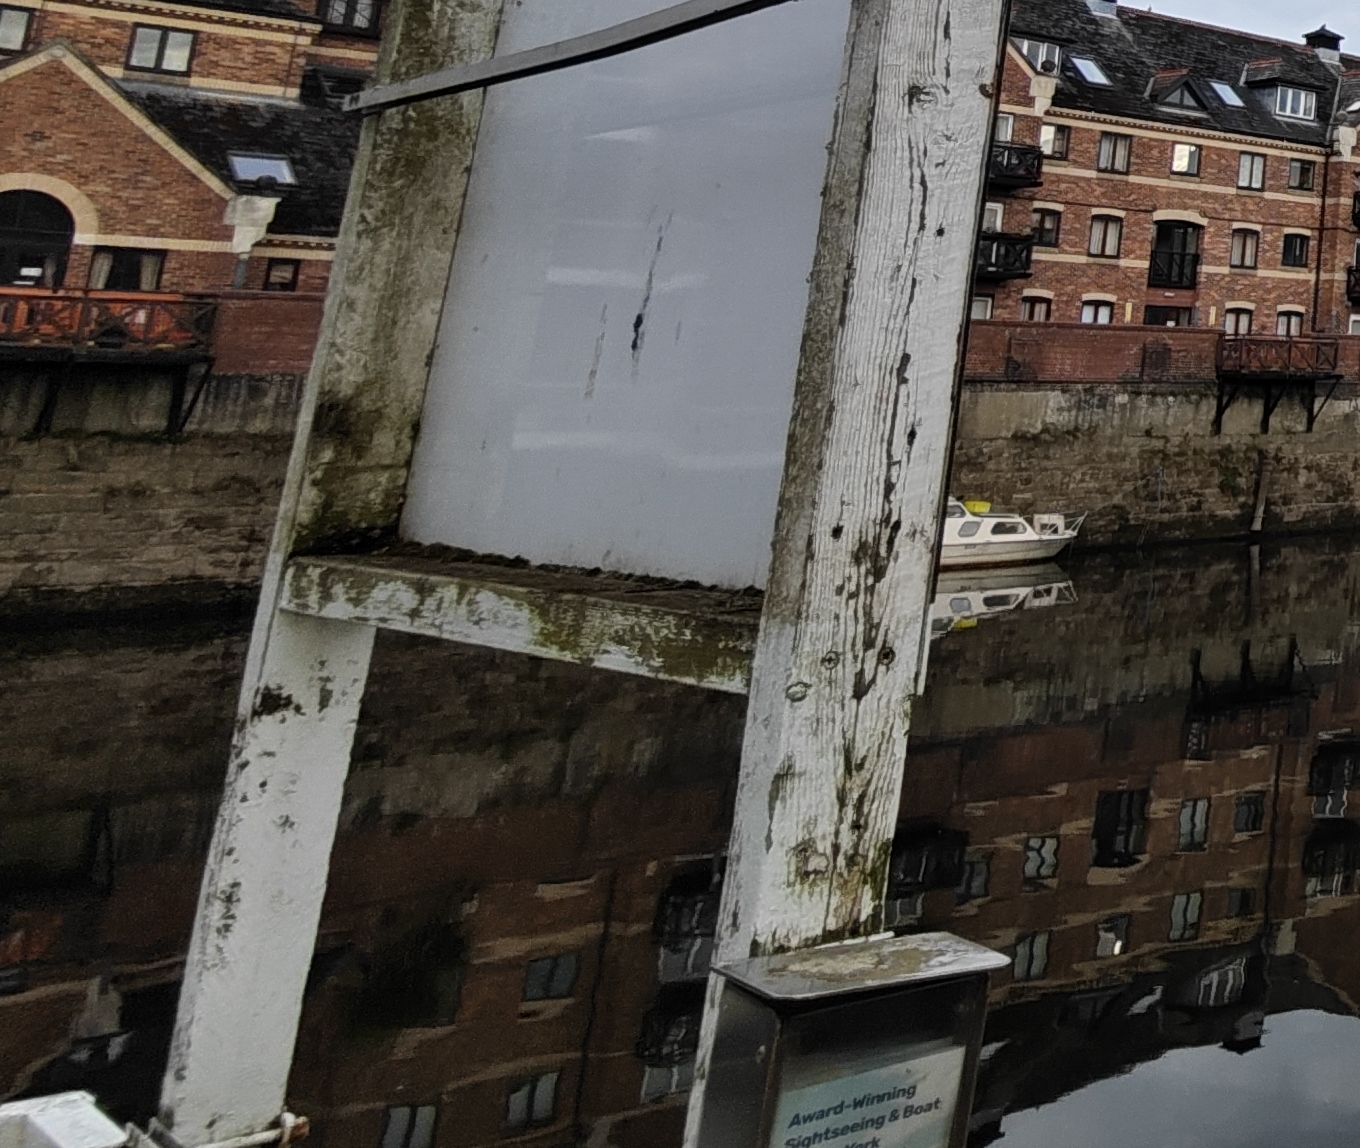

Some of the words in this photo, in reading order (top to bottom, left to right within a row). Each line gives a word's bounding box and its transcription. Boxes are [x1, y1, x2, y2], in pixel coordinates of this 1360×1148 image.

[785, 1114, 886, 1148] Sightseeing
[888, 1109, 901, 1123] &
[903, 1097, 942, 1119] Boat
[788, 1085, 917, 1129] Award-Winning
